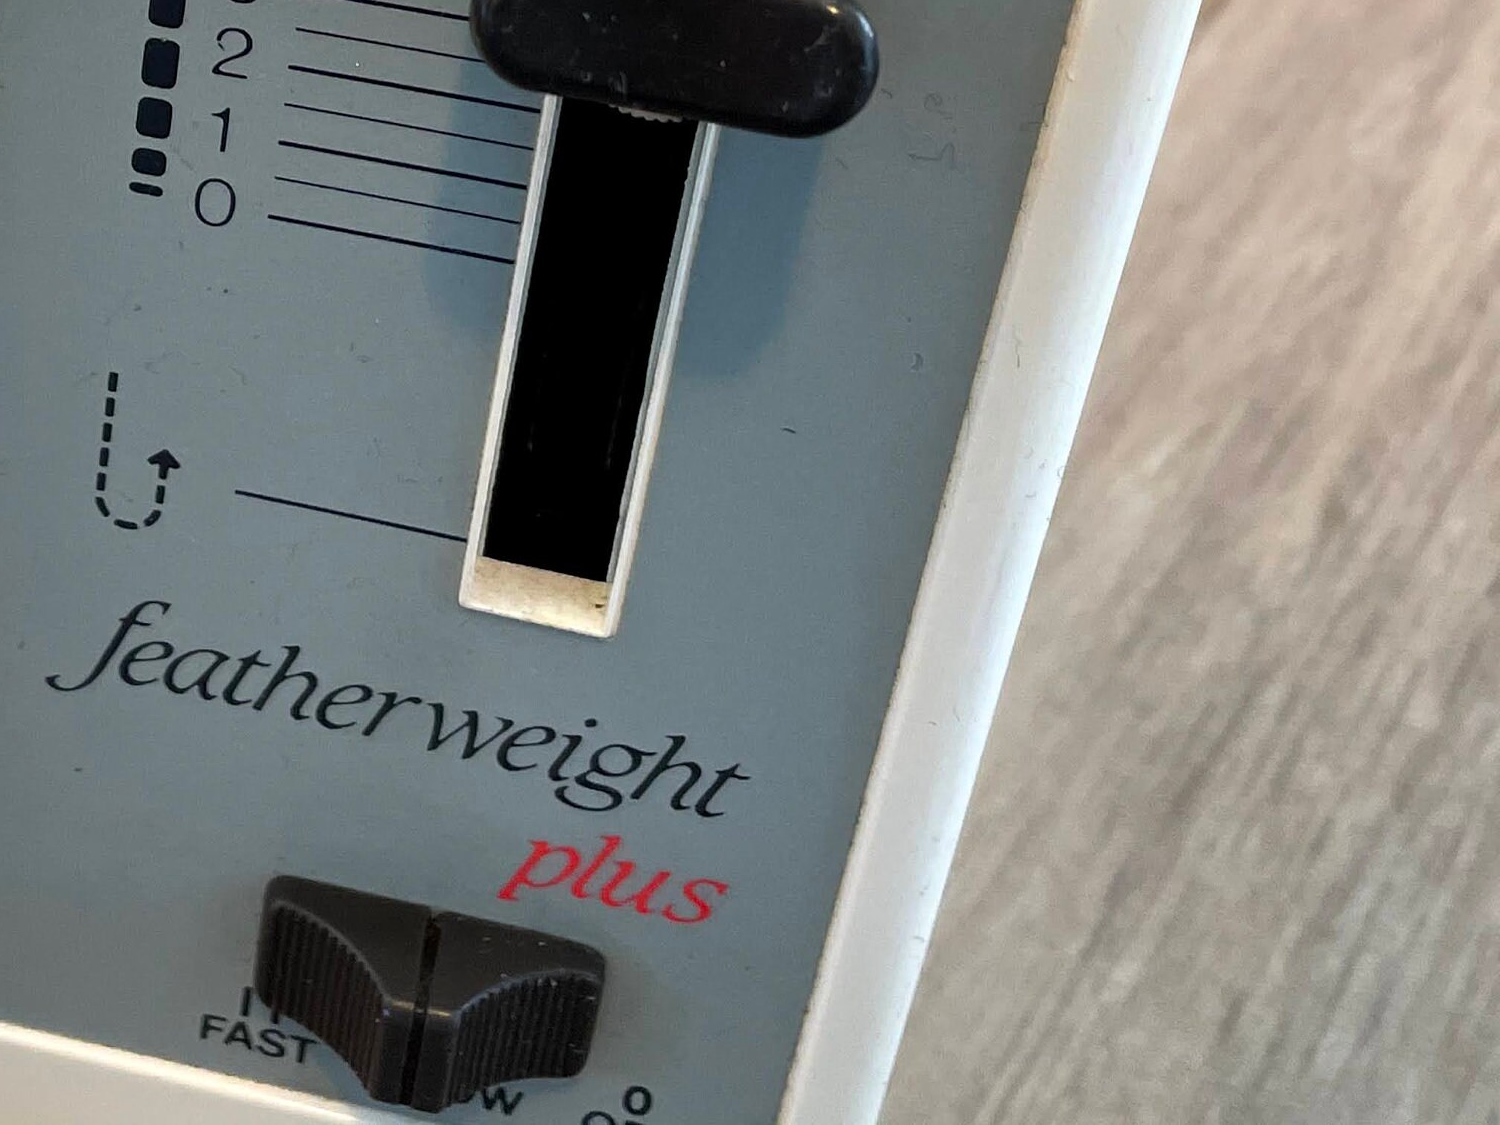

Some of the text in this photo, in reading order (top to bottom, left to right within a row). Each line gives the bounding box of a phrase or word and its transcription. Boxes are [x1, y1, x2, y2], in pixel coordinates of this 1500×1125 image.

[211, 27, 254, 80] 2
[211, 106, 231, 153] 1
[194, 177, 237, 228] 0
[44, 599, 751, 818] featherweight
[497, 835, 730, 925] plus
[199, 1012, 318, 1065] FAST
